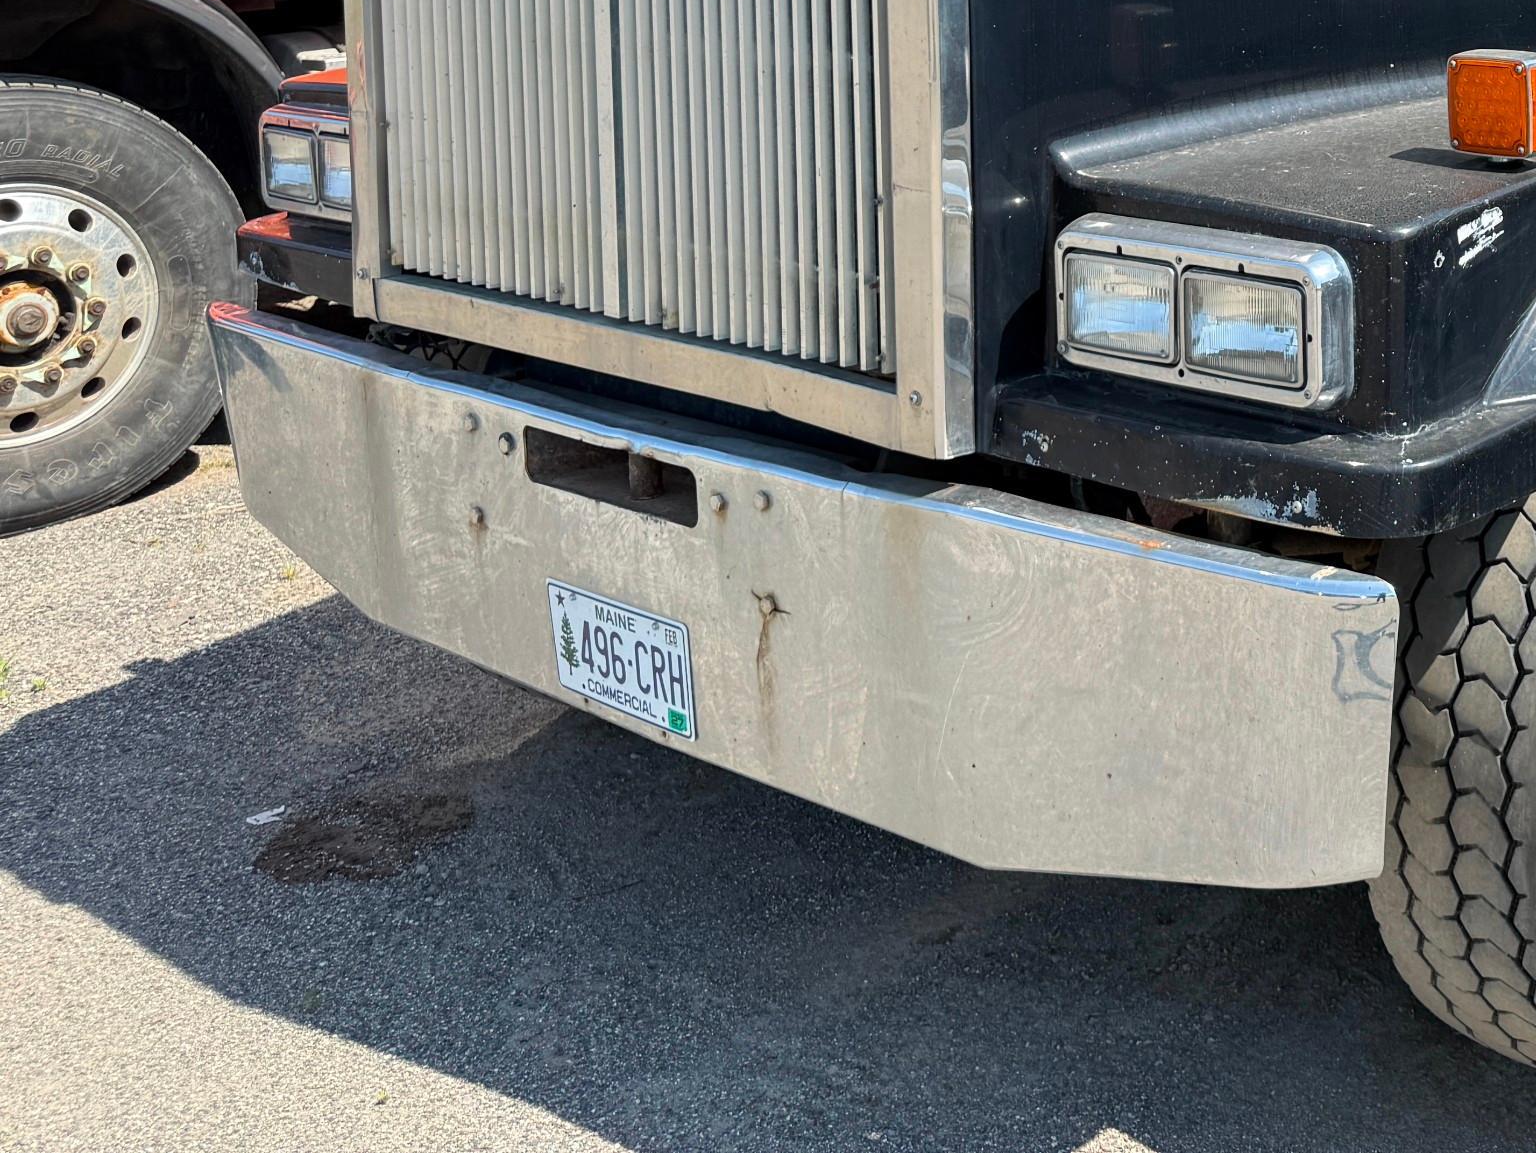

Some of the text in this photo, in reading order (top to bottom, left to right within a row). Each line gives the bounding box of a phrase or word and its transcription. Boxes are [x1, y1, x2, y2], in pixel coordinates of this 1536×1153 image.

[40, 144, 125, 178] RADIAL
[594, 604, 636, 633] MAINE
[664, 628, 678, 646] FEB
[587, 678, 657, 718] COMMERCIAL
